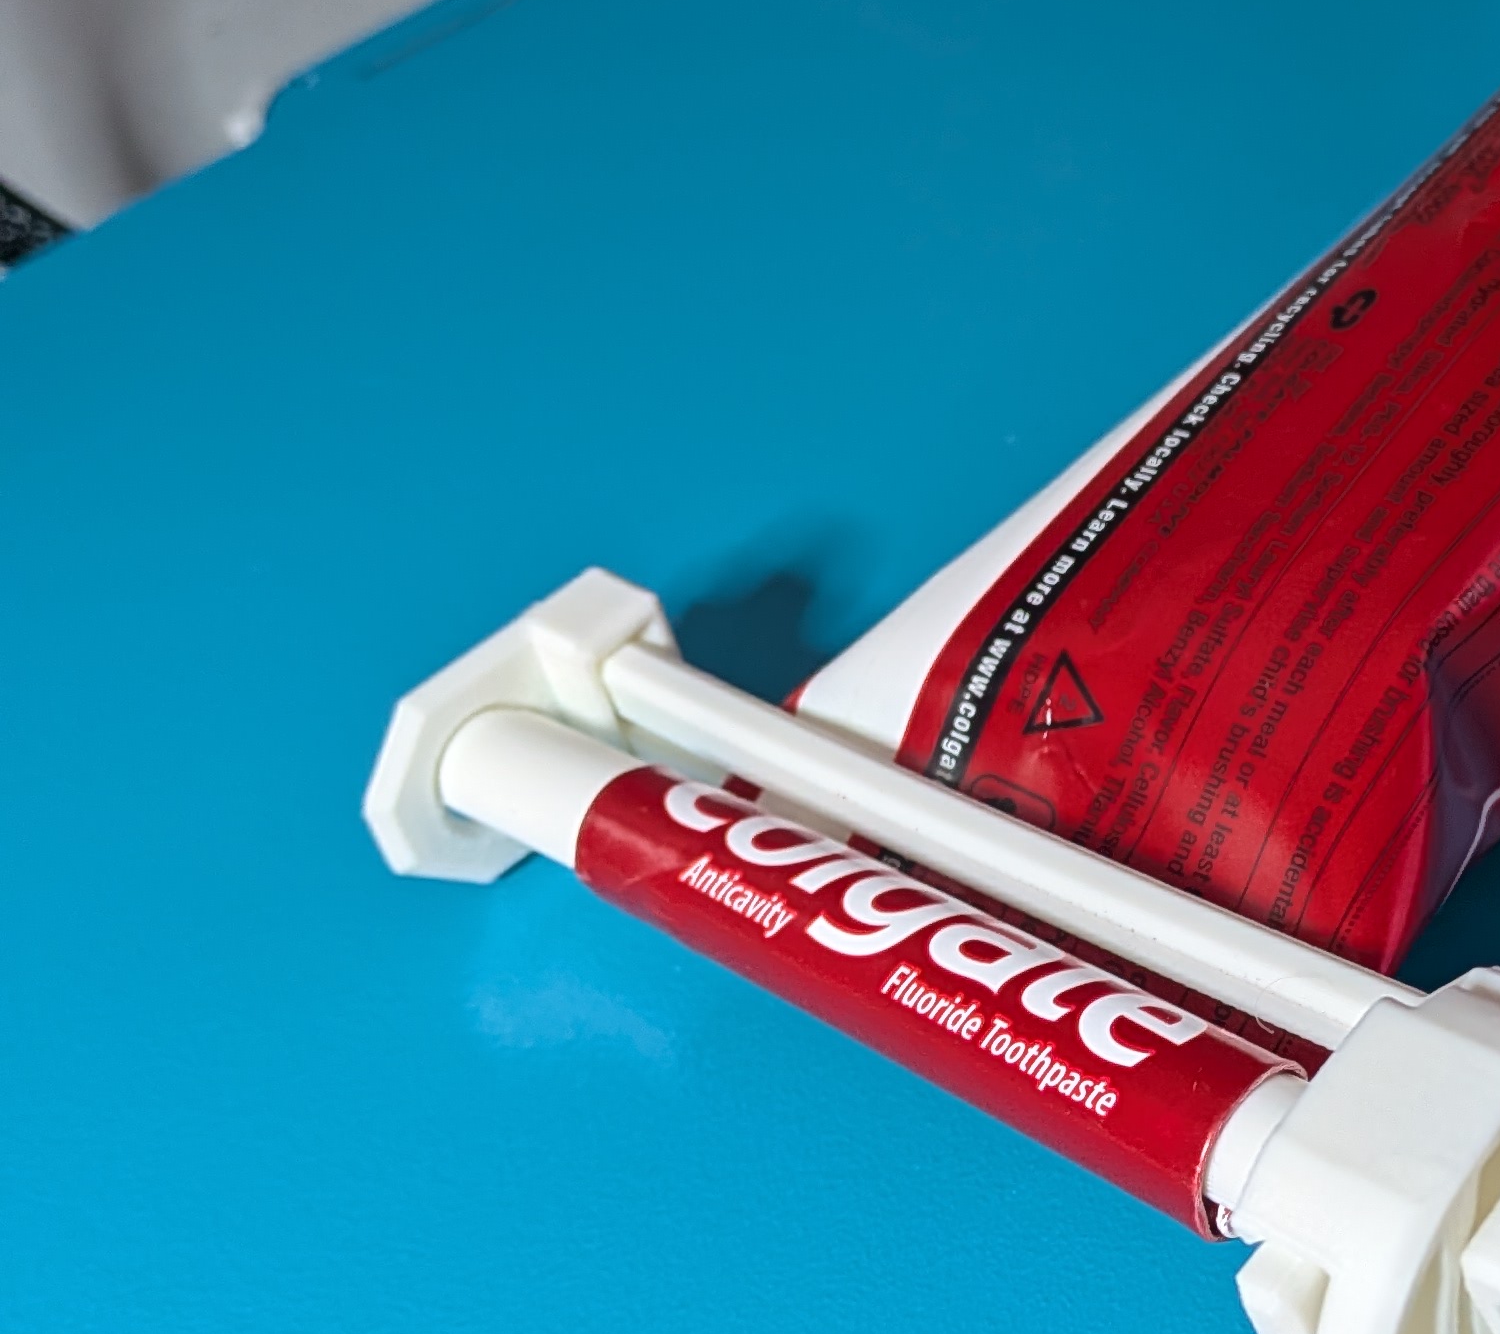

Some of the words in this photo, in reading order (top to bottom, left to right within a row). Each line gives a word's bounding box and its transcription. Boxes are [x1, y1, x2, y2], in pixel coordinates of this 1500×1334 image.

[1184, 370, 1239, 428] Check
[1442, 388, 1489, 438] sized
[1119, 428, 1189, 498] locally.
[1071, 496, 1126, 554] Learn
[1026, 554, 1074, 607] more
[1006, 609, 1028, 636] at
[1281, 640, 1326, 700] each
[1247, 699, 1290, 763] meal
[1333, 684, 1409, 783] brushing
[1183, 720, 1249, 828] brushing
[1234, 759, 1256, 788] or
[1323, 780, 1350, 806] is
[1221, 790, 1241, 822] at
[1165, 828, 1197, 879] and
[1192, 819, 1233, 884] least
[679, 853, 795, 939] Anticavity
[879, 965, 980, 1042] Fluoride
[979, 1018, 1118, 1118] Toothpaste
